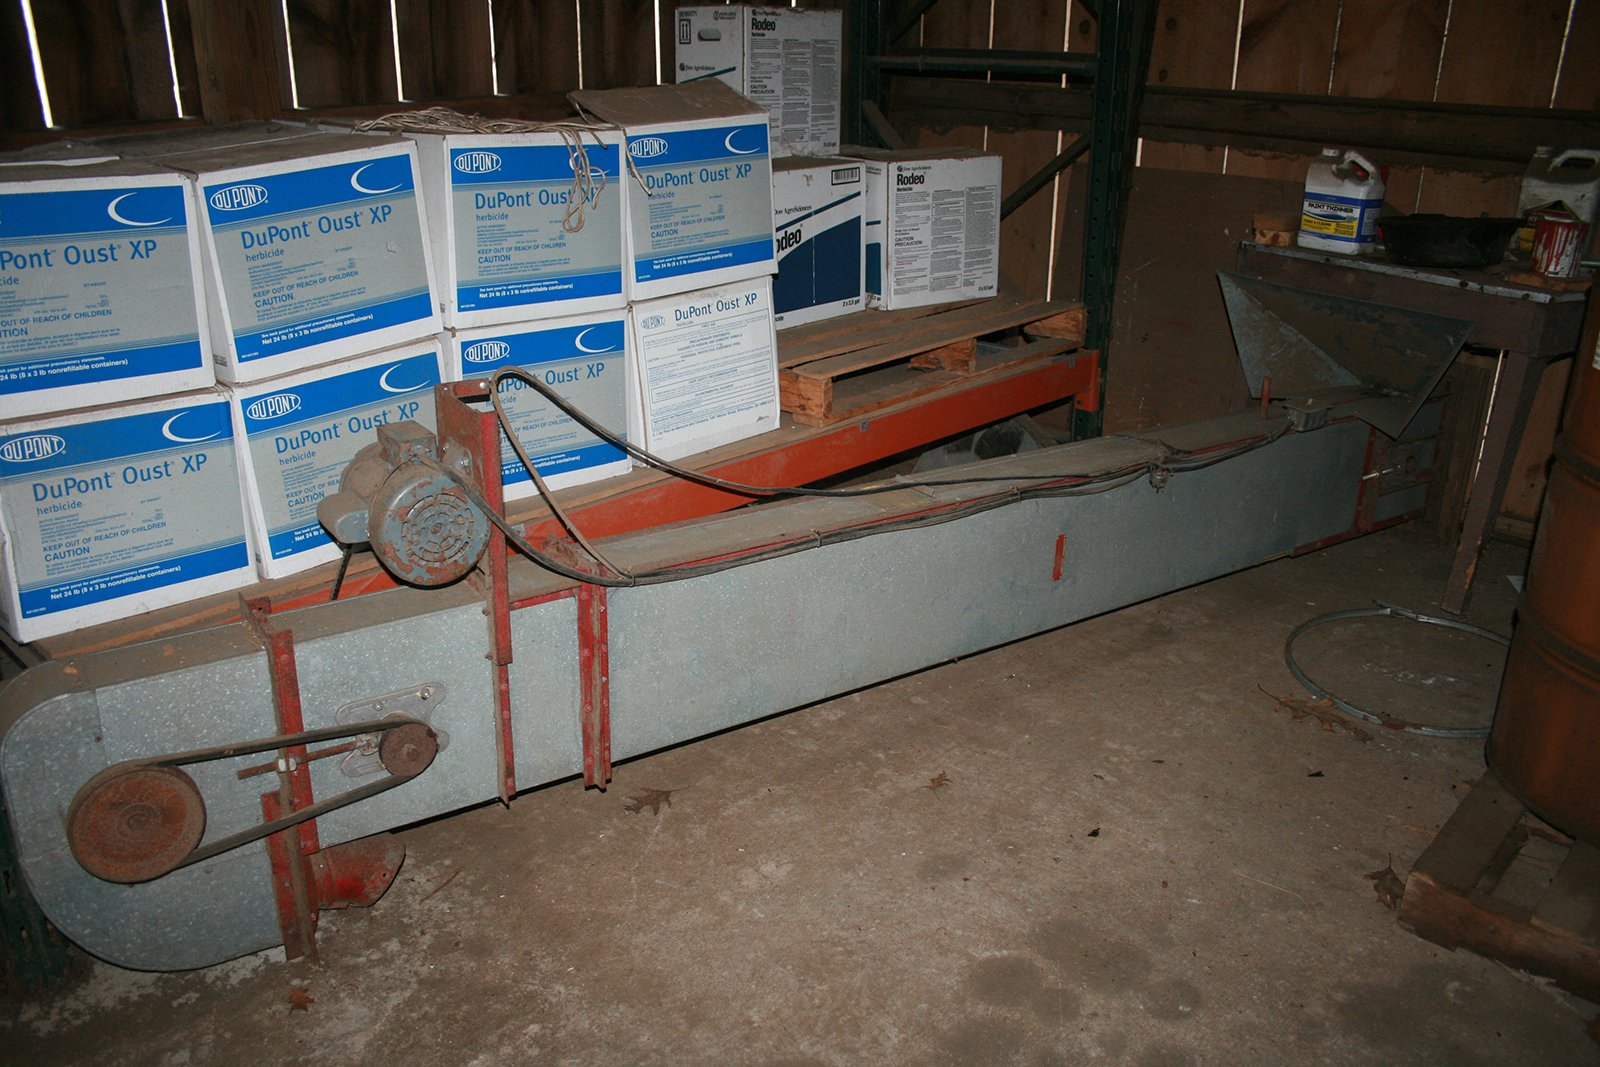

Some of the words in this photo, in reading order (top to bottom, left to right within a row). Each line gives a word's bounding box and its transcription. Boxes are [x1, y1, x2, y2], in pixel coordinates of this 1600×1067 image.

[751, 17, 776, 31] Rodeo
[631, 142, 643, 156] DU
[643, 140, 665, 155] PONT
[458, 155, 471, 171] DU
[473, 154, 498, 170] PONT
[646, 172, 693, 190] DuPont
[700, 166, 730, 183] Oust
[736, 163, 752, 179] XP
[896, 172, 925, 186] Rodeo
[215, 191, 231, 209] DU
[231, 186, 263, 208] PONT
[476, 191, 531, 209] DuPont
[784, 205, 812, 214] AgroSciences
[1308, 202, 1325, 210] PAINT
[1326, 204, 1354, 214] THINNER
[476, 213, 509, 222] herbicide
[241, 220, 310, 249] DuPont
[318, 212, 361, 234] Oust
[369, 204, 392, 225] XP
[651, 228, 679, 239] CAUTION
[0, 249, 53, 270] Pont
[64, 243, 118, 265] Oust
[130, 239, 157, 260] XP
[246, 248, 285, 263] herbicide
[478, 254, 511, 264] CAUTION
[253, 290, 269, 298] KEEP
[296, 280, 318, 289] REACH
[328, 271, 359, 281] CHILDREN
[255, 293, 294, 308] CAUTION
[675, 304, 712, 321] DuPont
[716, 298, 740, 312] Oust
[745, 293, 758, 306] XP
[1, 319, 17, 327] OUT
[20, 317, 31, 325] OF
[33, 313, 60, 323] REACH
[61, 312, 73, 320] OF
[74, 309, 112, 319] CHILDREN
[0, 327, 28, 338] TION
[262, 337, 272, 345] Net
[468, 347, 481, 361] DU
[482, 343, 505, 360] PONT
[48, 363, 90, 374] nonrefillable
[91, 358, 128, 369] containers)
[545, 369, 579, 385] Oust
[587, 362, 605, 379] XP
[251, 403, 267, 418] DU
[267, 395, 296, 417] PONT
[275, 423, 340, 454] DuPont
[348, 410, 389, 434] Oust
[397, 401, 419, 422] XP
[4, 443, 22, 460] DU
[23, 436, 60, 458] PONT
[279, 450, 317, 466] herbicide
[33, 471, 113, 502] DuPont
[122, 460, 172, 485] Oust
[181, 453, 208, 474] XP
[286, 489, 303, 498] KEEP
[304, 485, 316, 493] OUT
[288, 490, 325, 508] CAUTION
[36, 500, 82, 515] herbicide
[43, 542, 63, 552] KEEP
[65, 539, 80, 548] OUT
[82, 536, 93, 544] OF
[94, 531, 119, 541] REACH
[120, 528, 130, 536] OF
[132, 522, 166, 534] CHILDREN
[44, 546, 90, 562] CAUTION
[51, 592, 62, 601] Net
[81, 587, 88, 595] (8
[108, 574, 146, 587] nonrefillable
[147, 565, 182, 578] containers)
